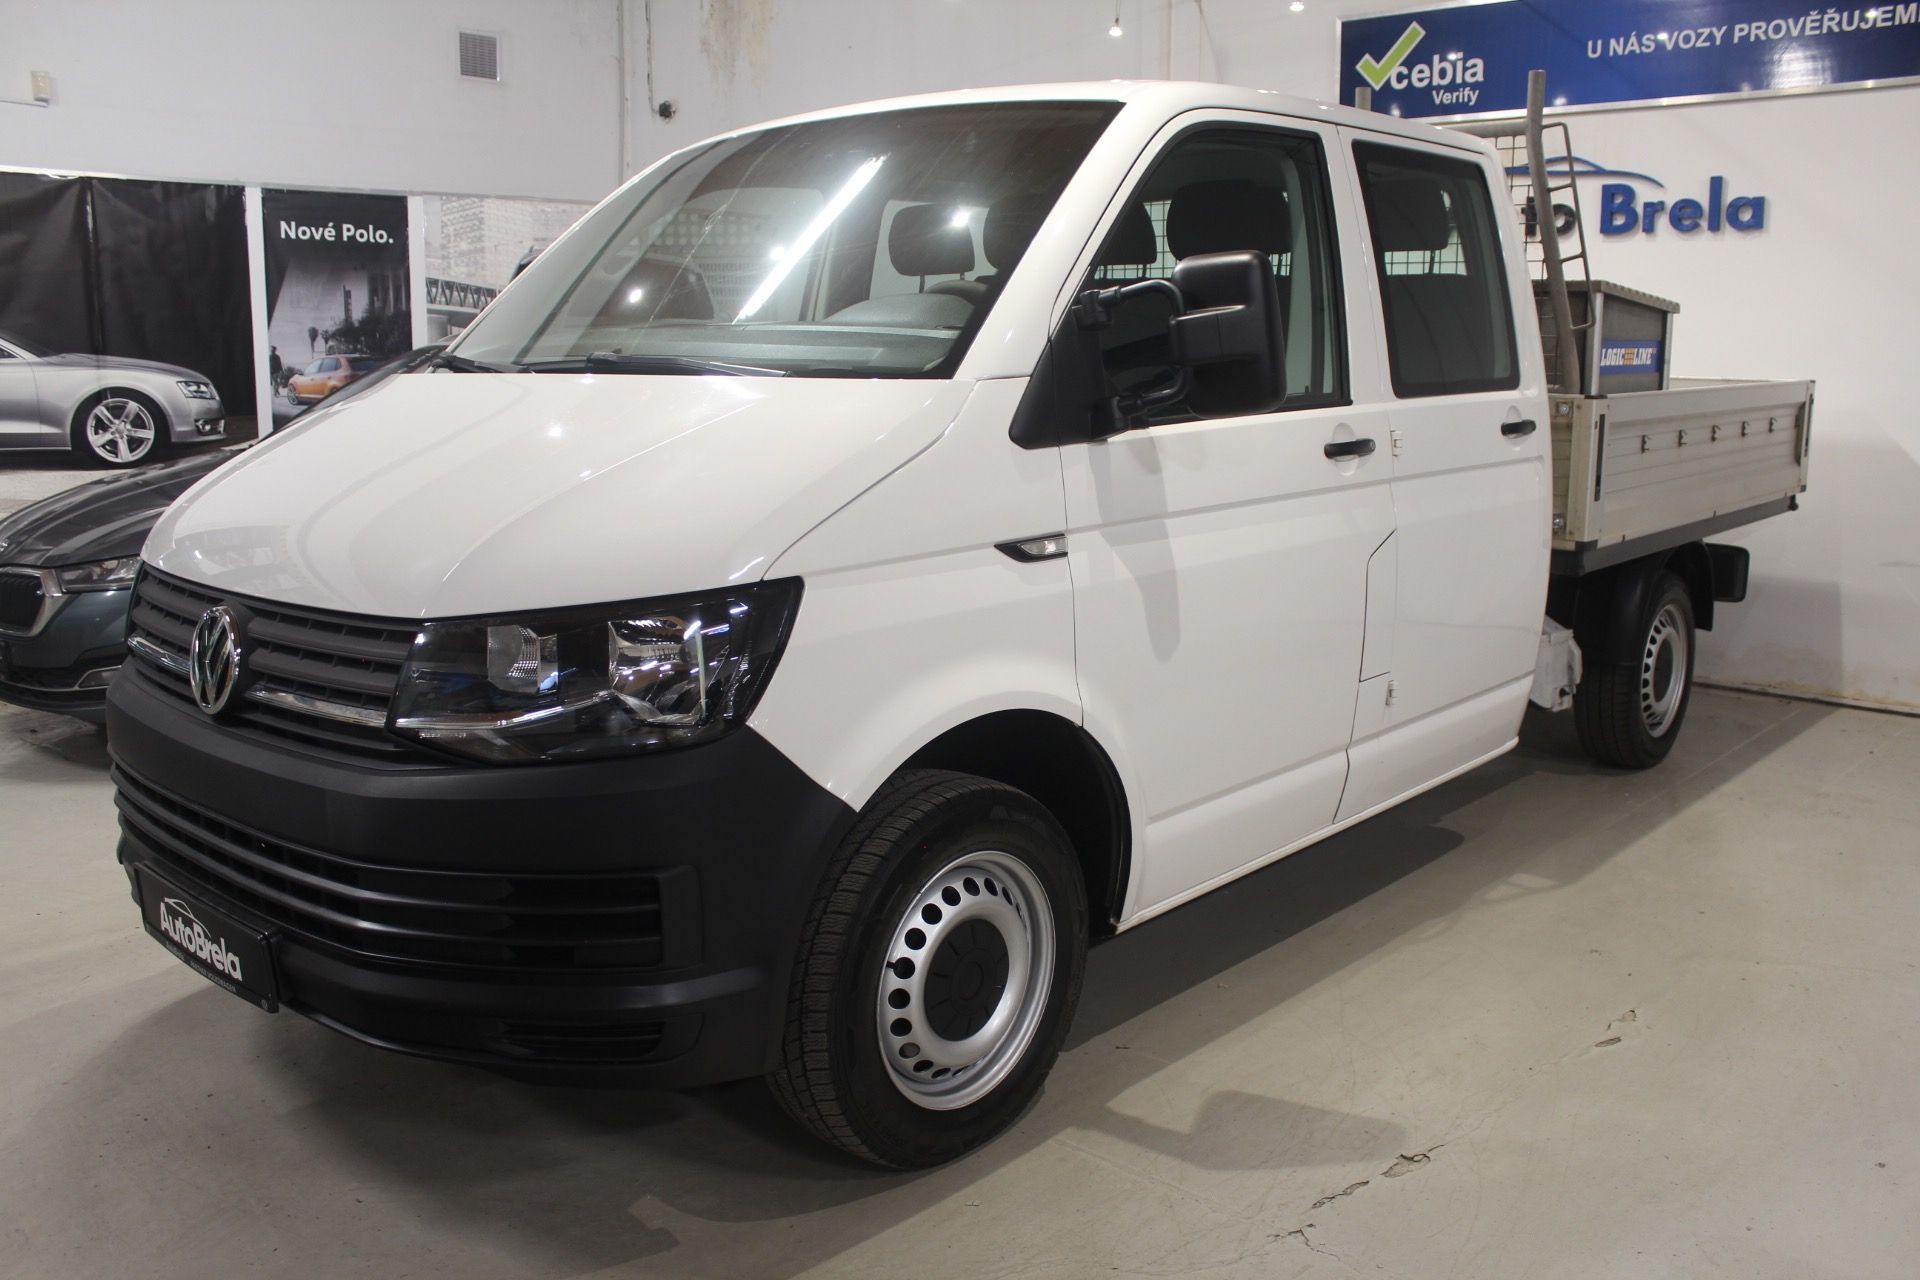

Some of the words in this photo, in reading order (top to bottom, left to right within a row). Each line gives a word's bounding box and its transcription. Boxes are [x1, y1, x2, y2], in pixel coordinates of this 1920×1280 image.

[1586, 39, 1603, 59] U
[1608, 31, 1656, 57] NÁS
[1658, 25, 1728, 50] VOZY
[1733, 2, 1920, 44] PROVĚŘUJEM
[1389, 51, 1485, 90] cebia
[1432, 86, 1480, 106] Verify
[1599, 175, 1766, 236] Brela
[279, 220, 336, 241] Nové
[342, 223, 394, 244] Polo.
[1600, 347, 1625, 366] LOGIC
[1632, 347, 1653, 366] LINE
[160, 901, 243, 982] AutoBrela
